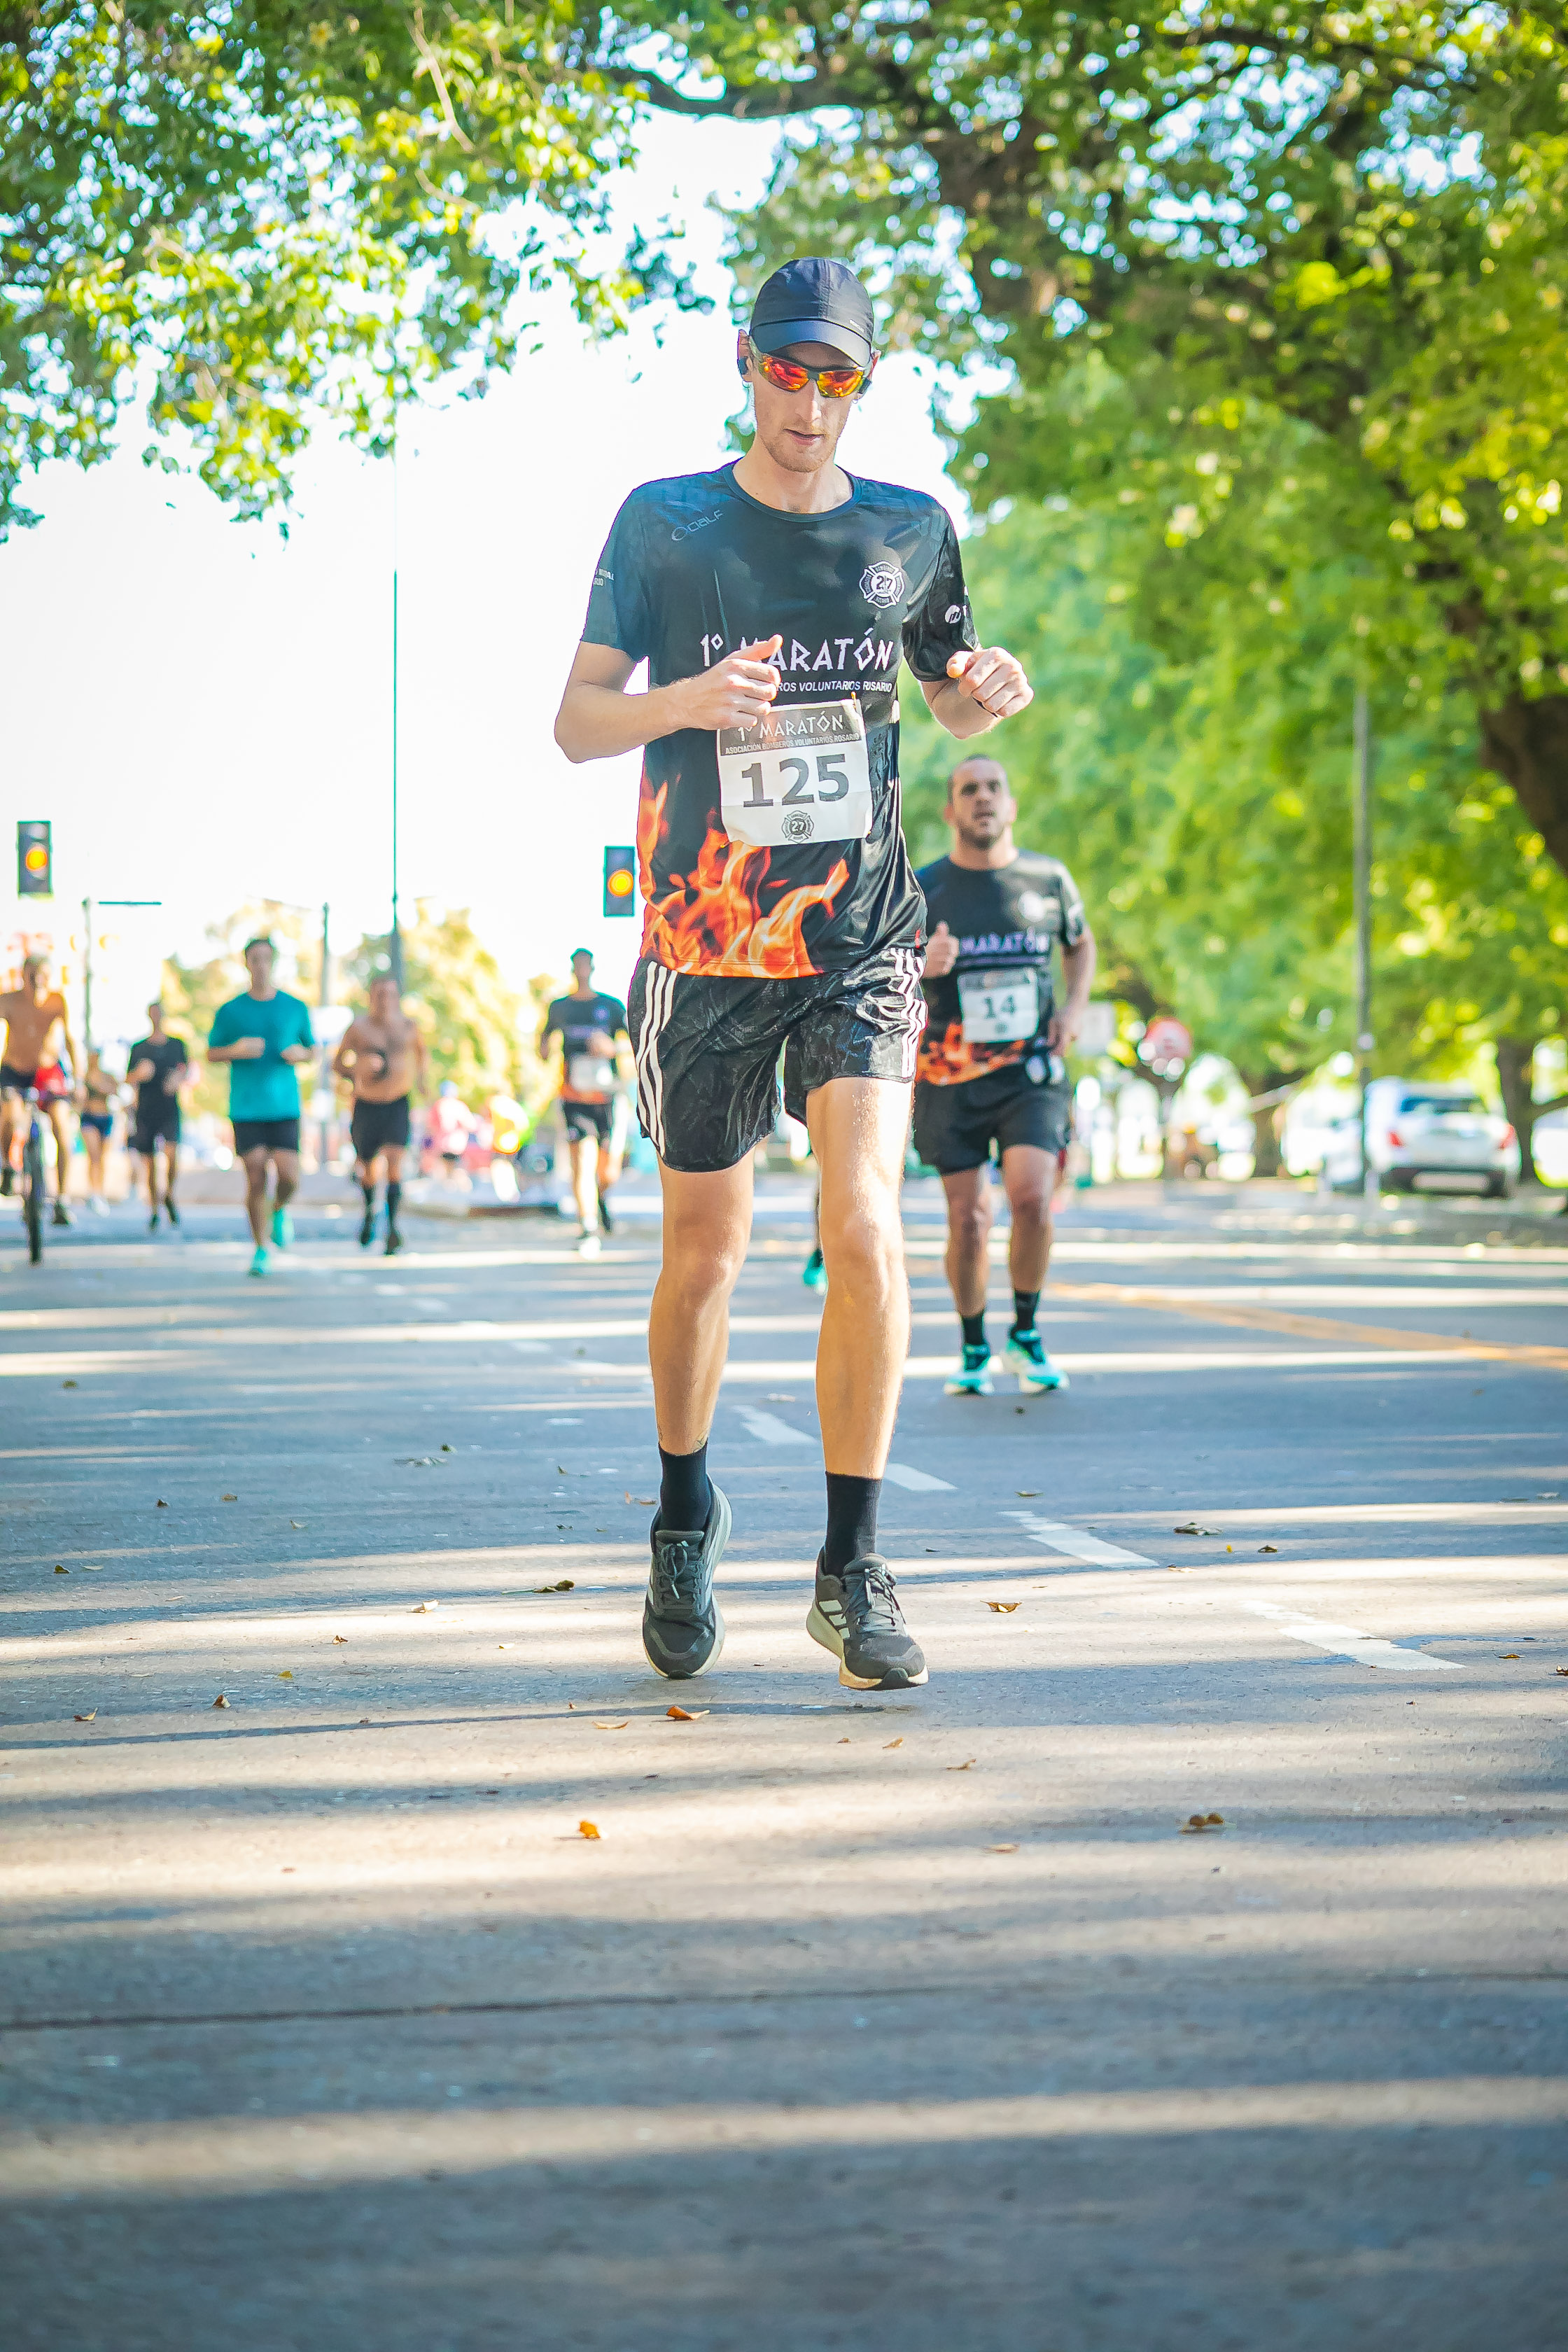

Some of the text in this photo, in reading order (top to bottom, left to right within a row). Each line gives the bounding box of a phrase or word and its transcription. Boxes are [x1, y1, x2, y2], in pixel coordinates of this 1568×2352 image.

[876, 575, 892, 590] 27
[799, 680, 860, 692] VOLUNTARIOS
[760, 710, 844, 739] MARATÓN
[725, 732, 860, 755] ASOCIACIÓN BOMBEROS VOLUNTARIOS ROSARIO
[741, 753, 849, 808] 125
[791, 820, 805, 832] 27
[983, 995, 1017, 1019] 14
